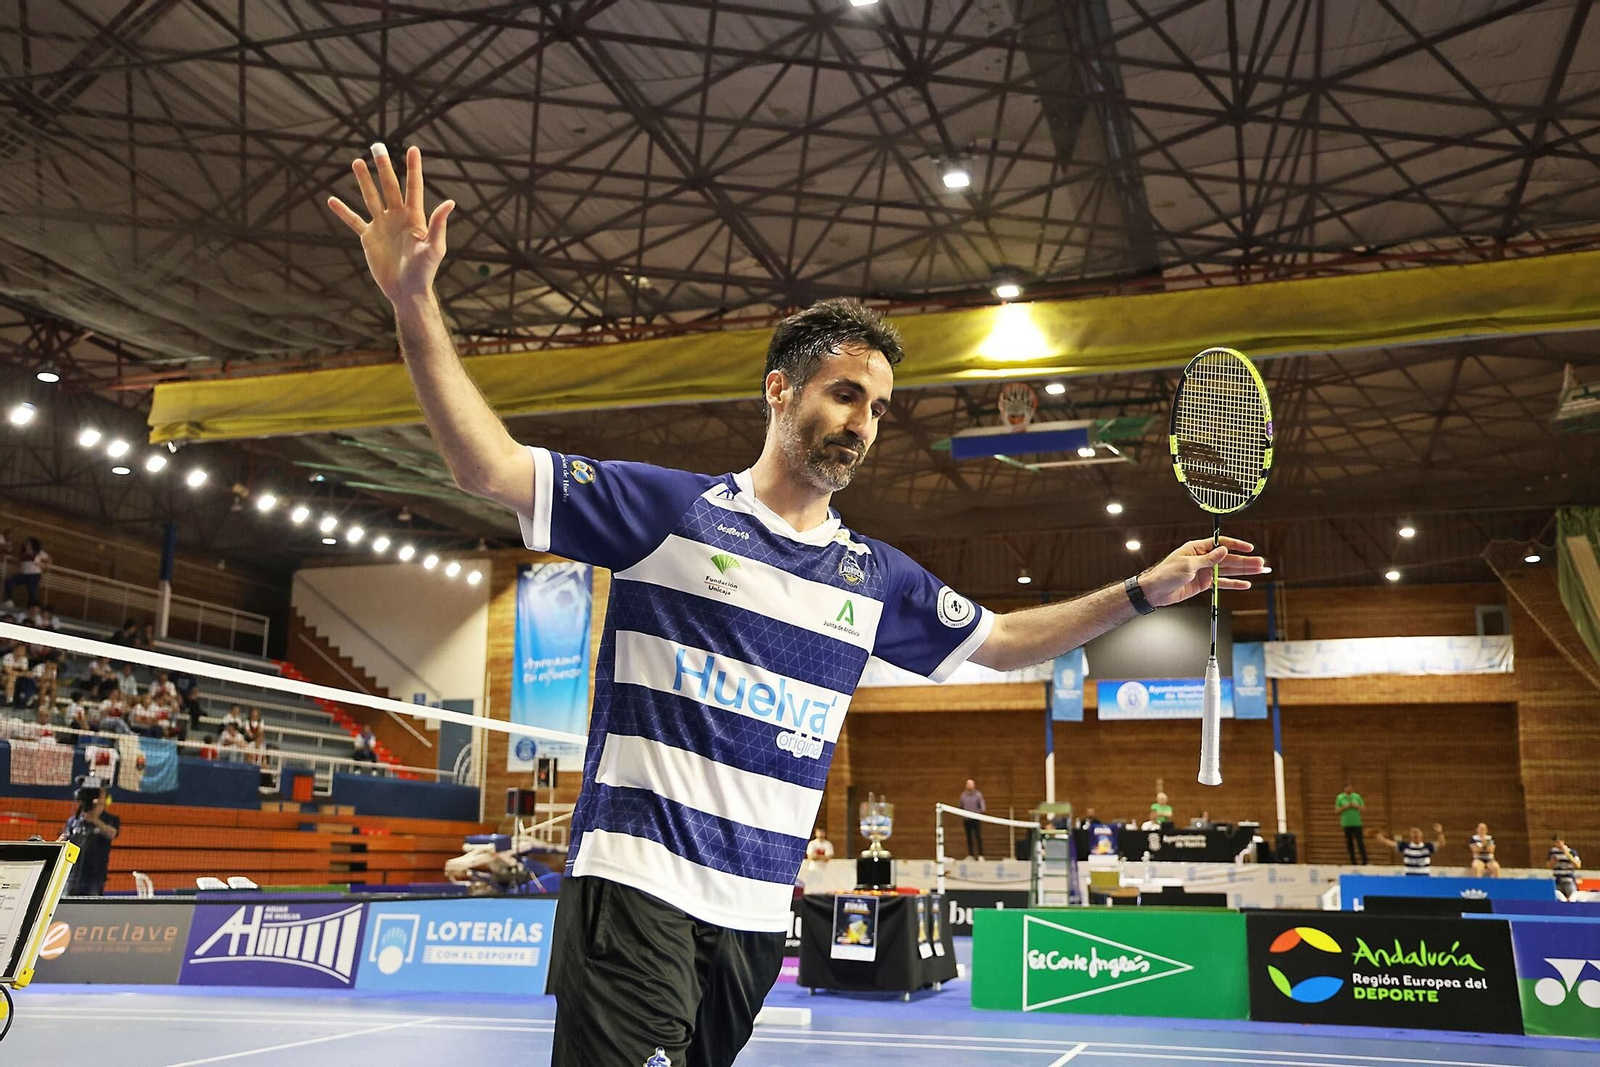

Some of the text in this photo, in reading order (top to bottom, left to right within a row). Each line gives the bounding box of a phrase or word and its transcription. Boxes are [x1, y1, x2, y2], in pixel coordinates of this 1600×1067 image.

[705, 575, 738, 589] Fundación
[708, 584, 731, 596] Unicaja
[823, 620, 837, 629] Junta
[673, 648, 838, 735] Huelva
[73, 922, 179, 942] enclave
[426, 917, 544, 943] LOTERÍAS
[436, 950, 527, 961] CON EL DEPORTE
[1028, 946, 1151, 979] El Corte Inglés
[1351, 936, 1486, 972] Andalucía
[1352, 972, 1489, 991] Región Europea del
[1353, 986, 1440, 1003] DEPORTE
